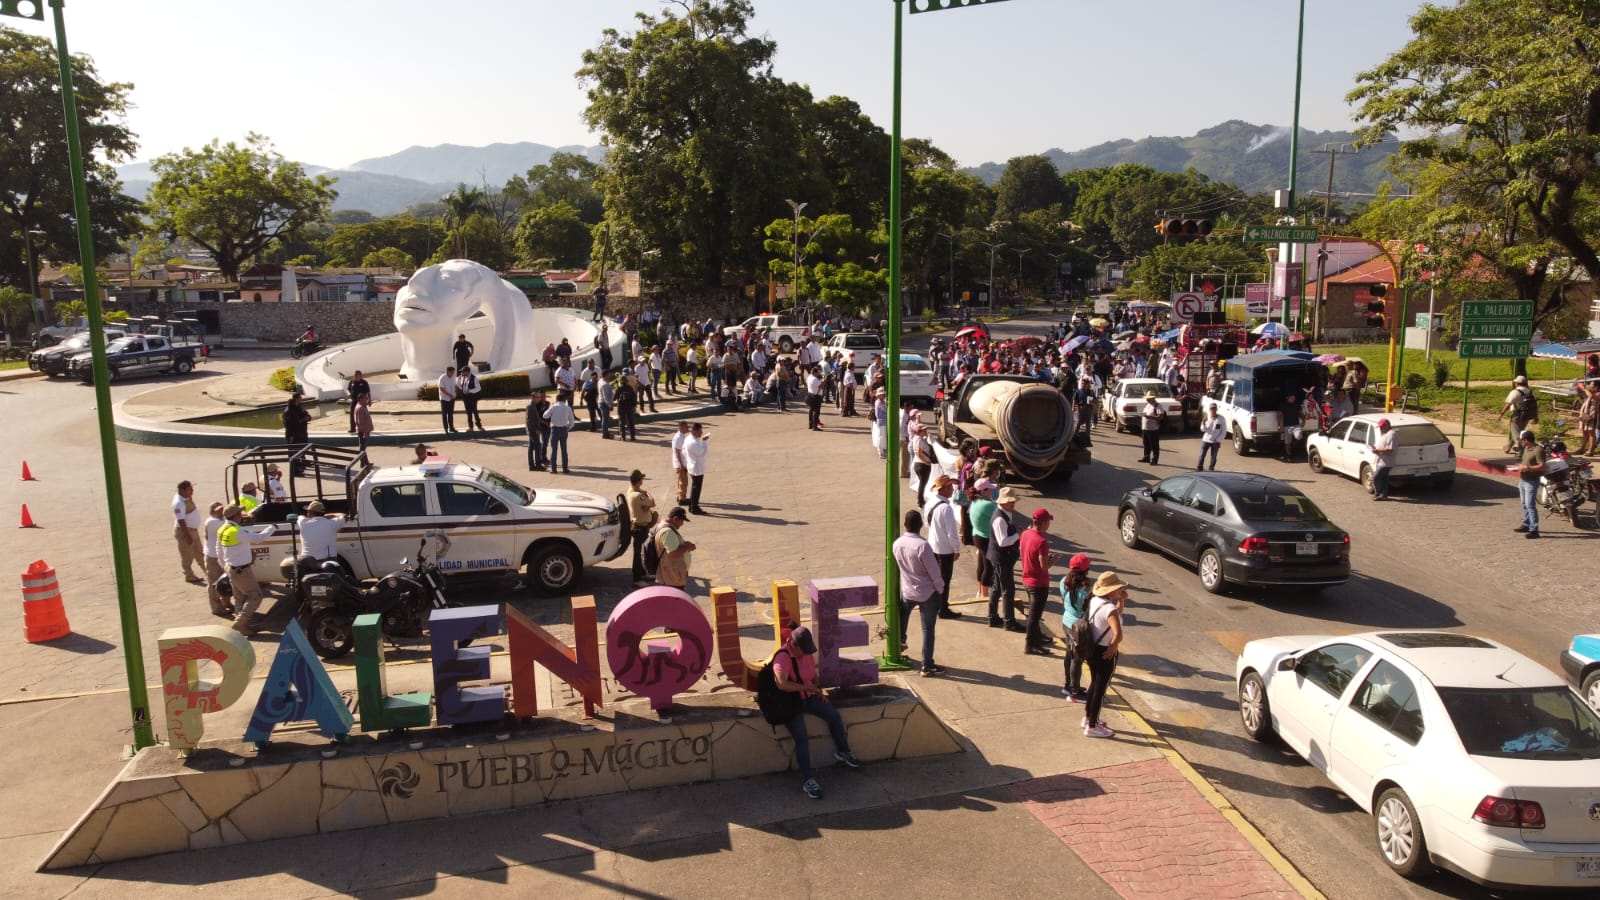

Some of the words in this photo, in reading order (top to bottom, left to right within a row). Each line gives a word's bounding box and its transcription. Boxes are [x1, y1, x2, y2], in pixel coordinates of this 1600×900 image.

[1260, 228, 1290, 239] PALENQUE
[1293, 229, 1316, 240] CENTRO
[1485, 304, 1522, 316] PALENQUE
[1526, 304, 1531, 315] 9
[1481, 324, 1515, 335] YAXCHILAN
[1517, 324, 1529, 335] 166
[1473, 344, 1493, 355] AGUA
[1497, 344, 1515, 355] AZUL
[438, 560, 462, 570] LIDAD
[467, 558, 510, 569] MUNICIPAL
[158, 577, 880, 752] PALENQUE
[433, 750, 570, 793] PUEBLO
